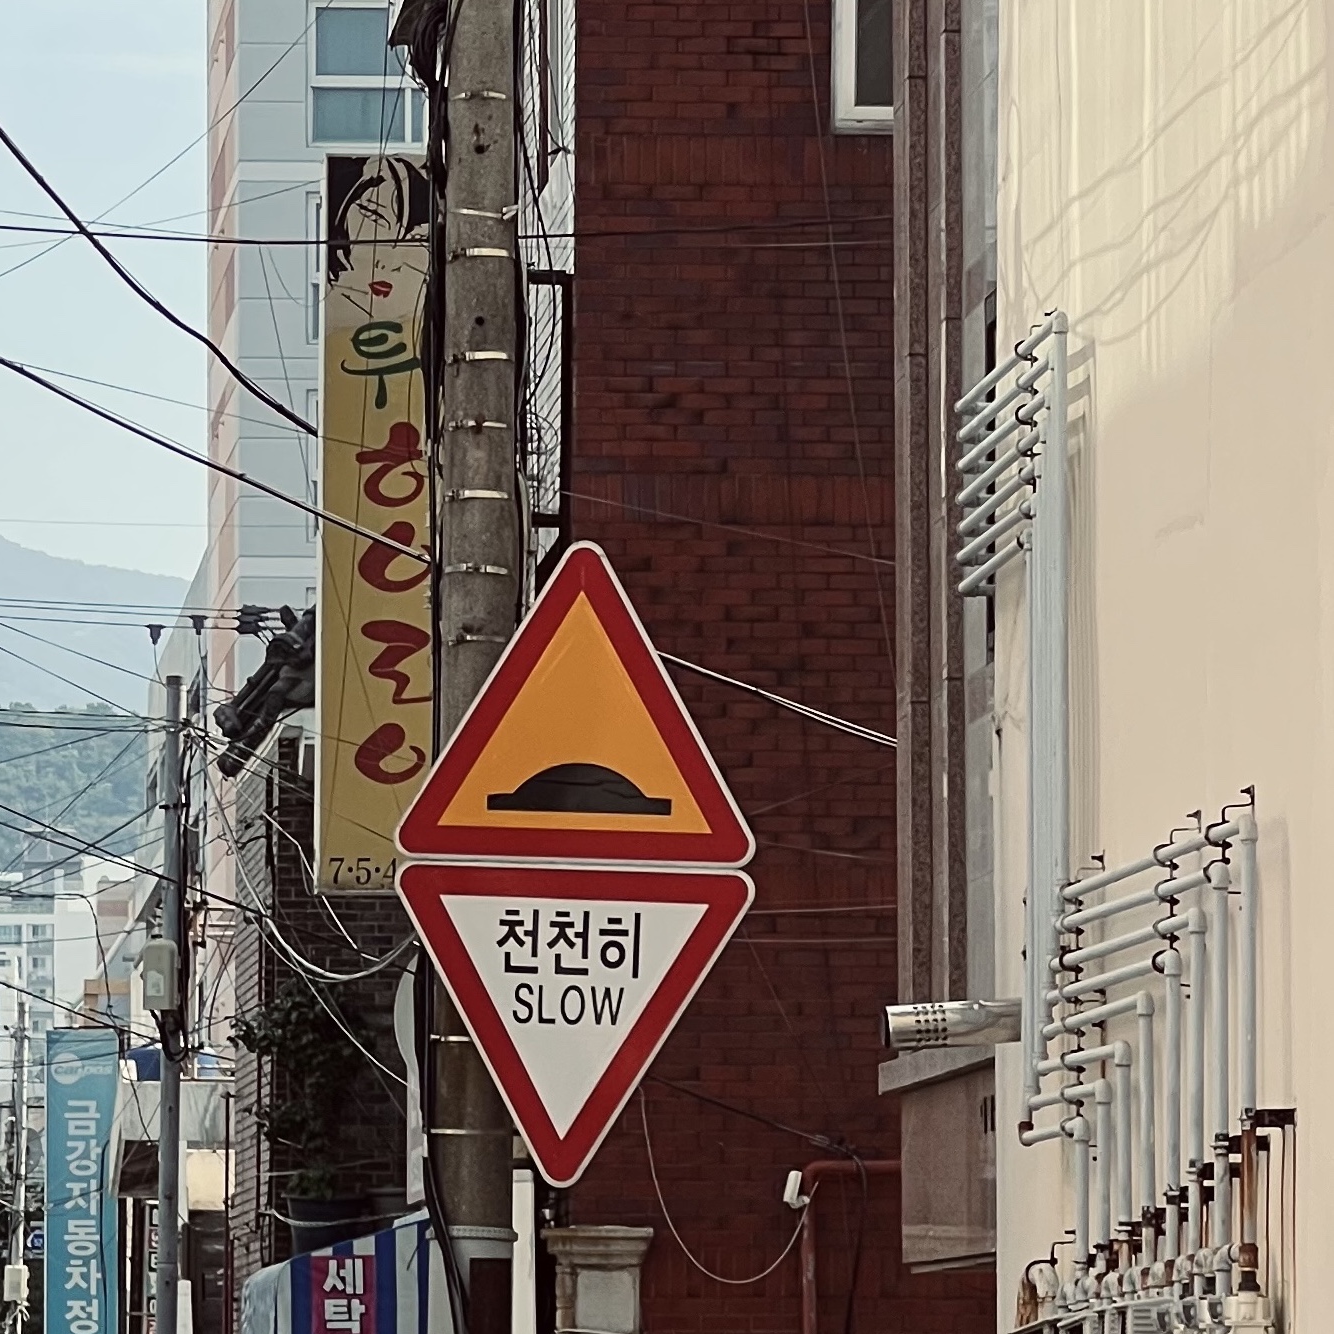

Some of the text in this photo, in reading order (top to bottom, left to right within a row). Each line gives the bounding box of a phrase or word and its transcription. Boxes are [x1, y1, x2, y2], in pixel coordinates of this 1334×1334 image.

[496, 908, 642, 979] 천천히
[512, 982, 625, 1026] SLOW
[322, 1258, 366, 1334] 세탁
